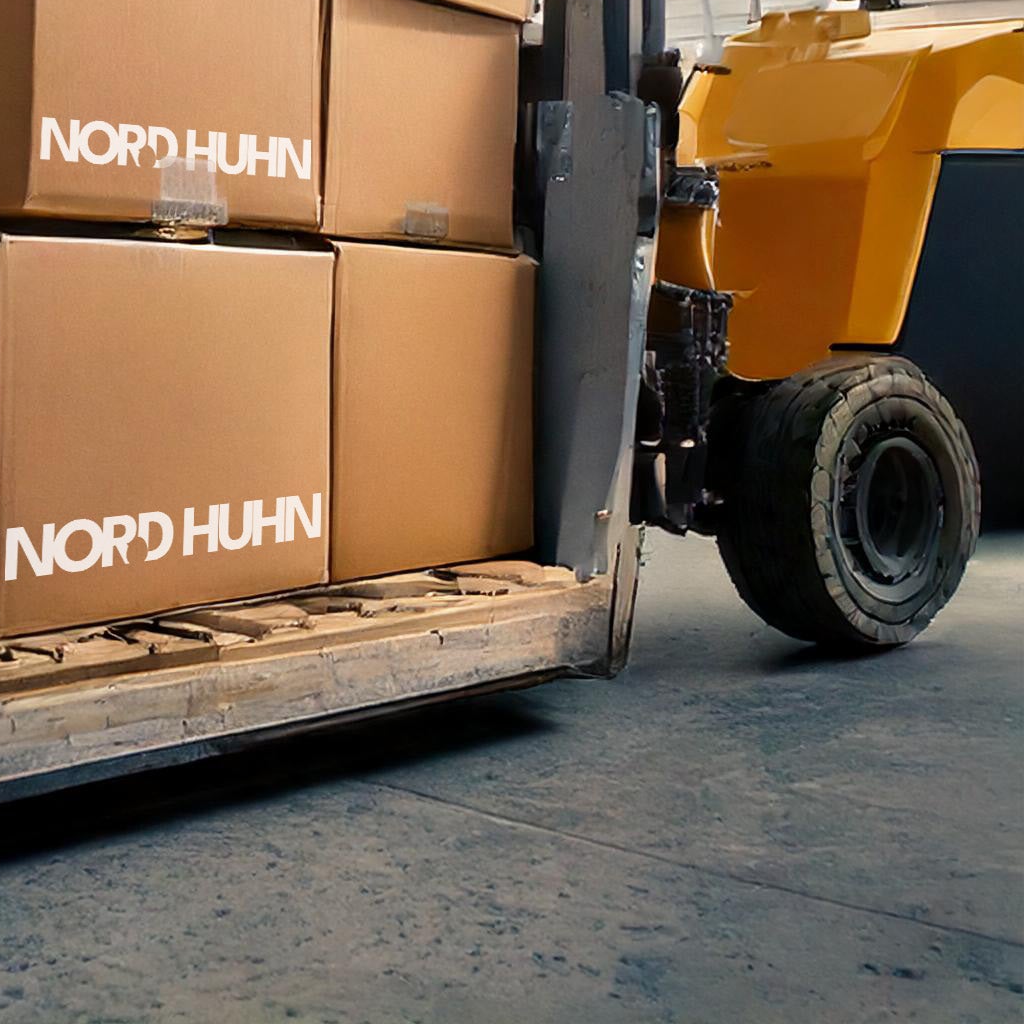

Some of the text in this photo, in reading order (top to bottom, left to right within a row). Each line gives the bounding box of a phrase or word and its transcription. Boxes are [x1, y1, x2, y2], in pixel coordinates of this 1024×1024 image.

[40, 116, 311, 180] NORD HUHN
[5, 492, 321, 581] NORD HUHN
